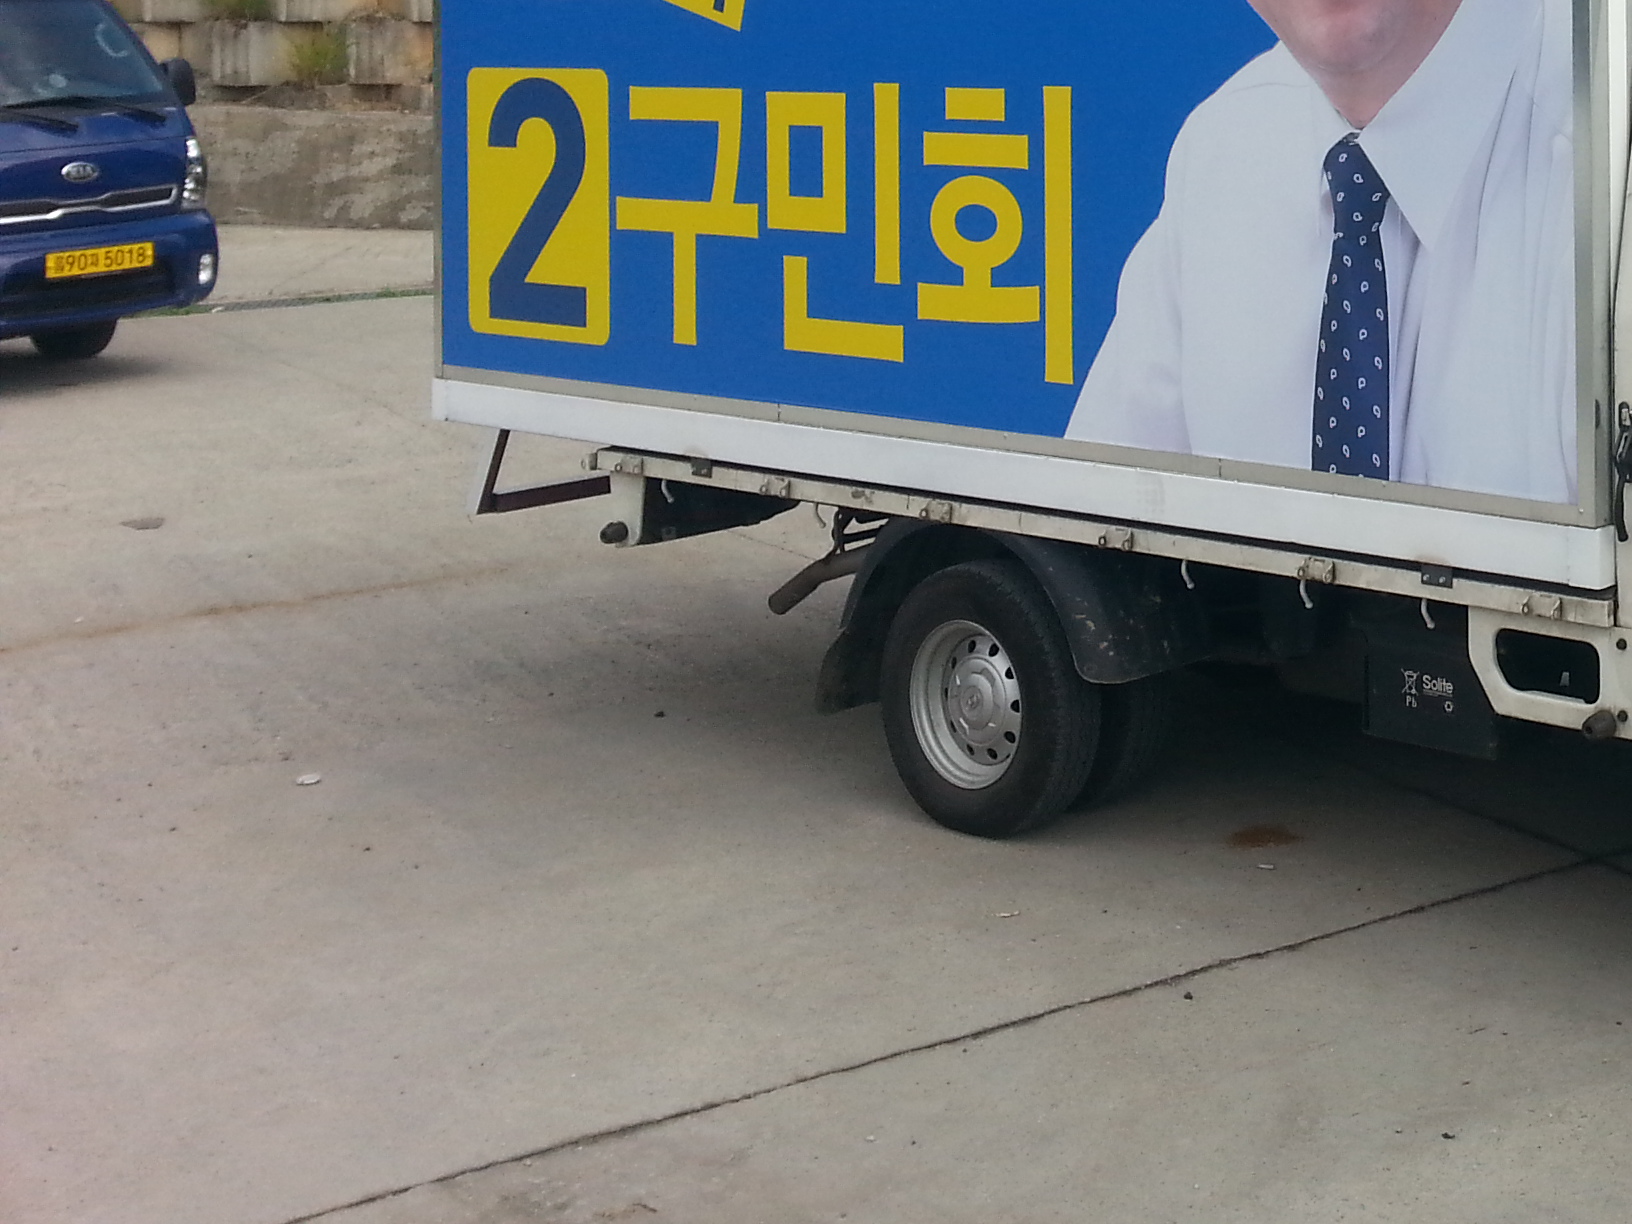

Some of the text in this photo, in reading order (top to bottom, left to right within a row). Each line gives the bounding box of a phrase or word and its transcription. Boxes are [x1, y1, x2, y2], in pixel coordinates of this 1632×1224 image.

[487, 76, 1074, 386] 2 구민회
[103, 245, 147, 269] 5018
[1422, 674, 1454, 694] Solite
[1405, 695, 1418, 708] Pb
